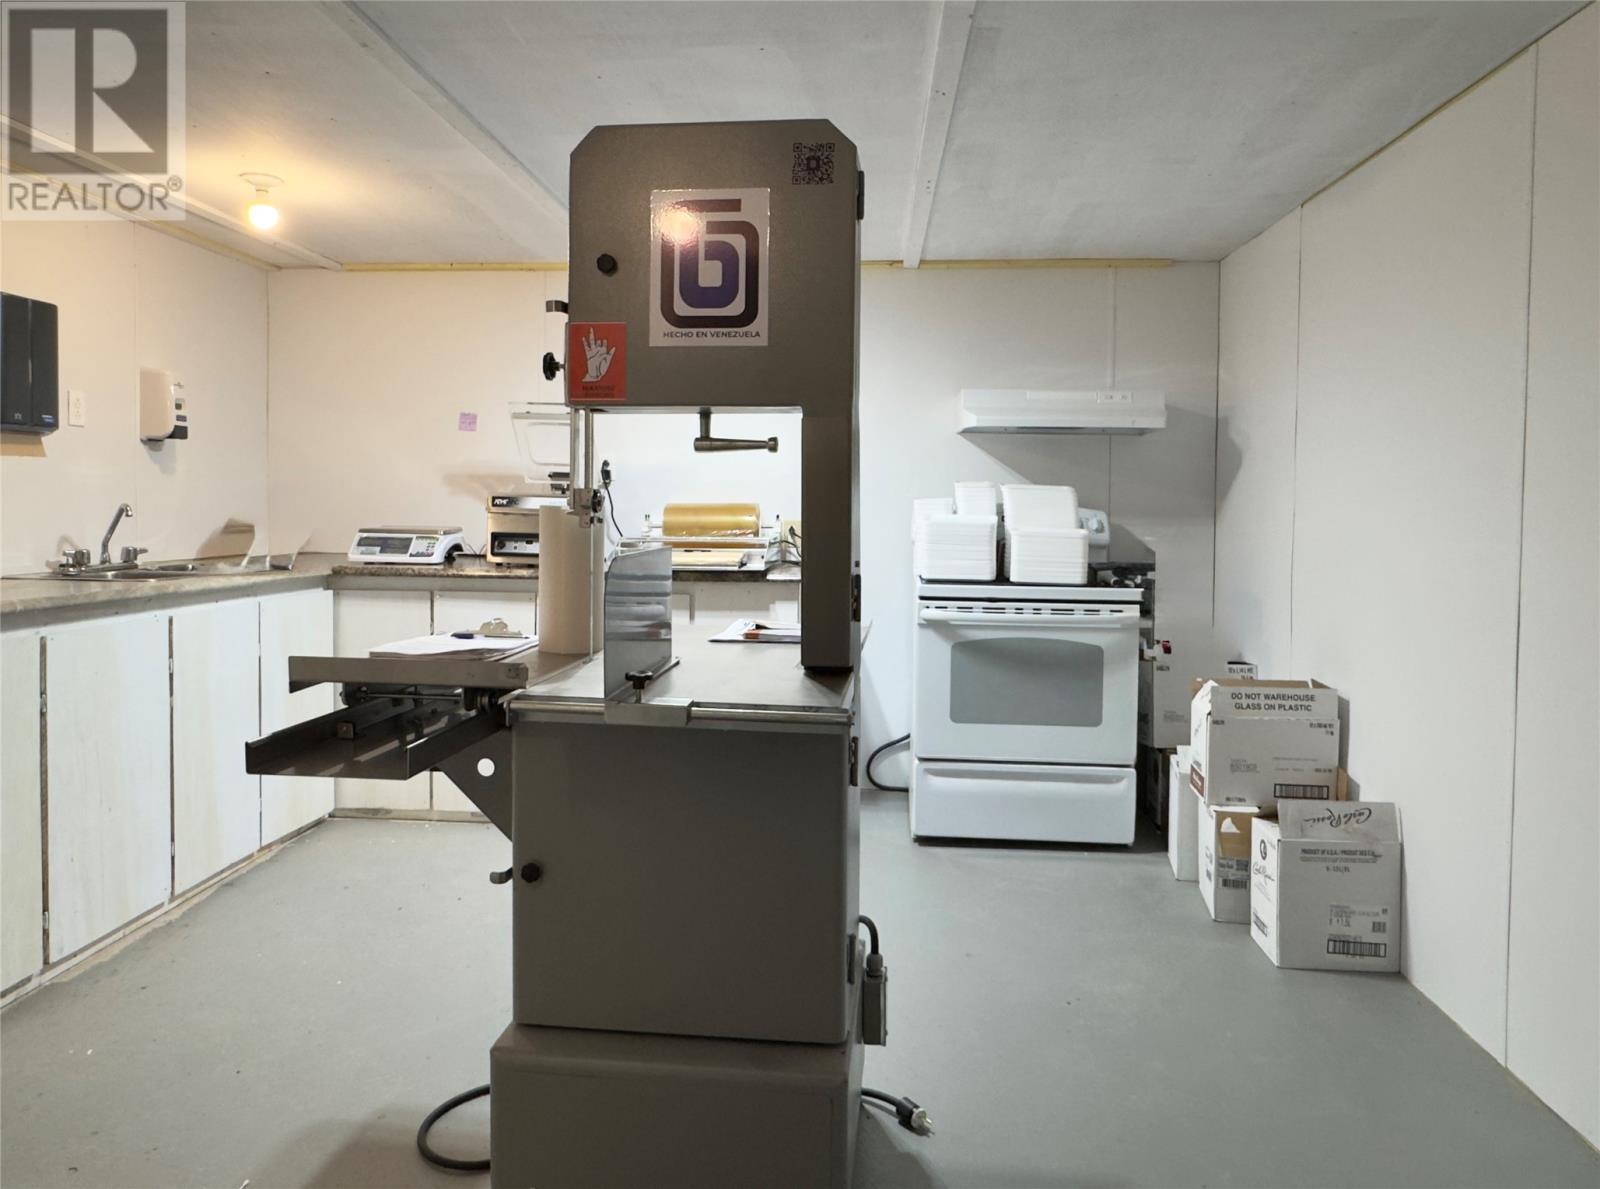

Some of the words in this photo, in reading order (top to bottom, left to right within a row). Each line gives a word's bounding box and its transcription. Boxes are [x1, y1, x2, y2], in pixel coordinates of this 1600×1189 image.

[1231, 692, 1243, 700] DO
[1263, 693, 1316, 702] WAREHOUSE
[1234, 702, 1262, 710] GLASS
[1263, 703, 1276, 711] ON
[1277, 703, 1312, 712] PLASTIC
